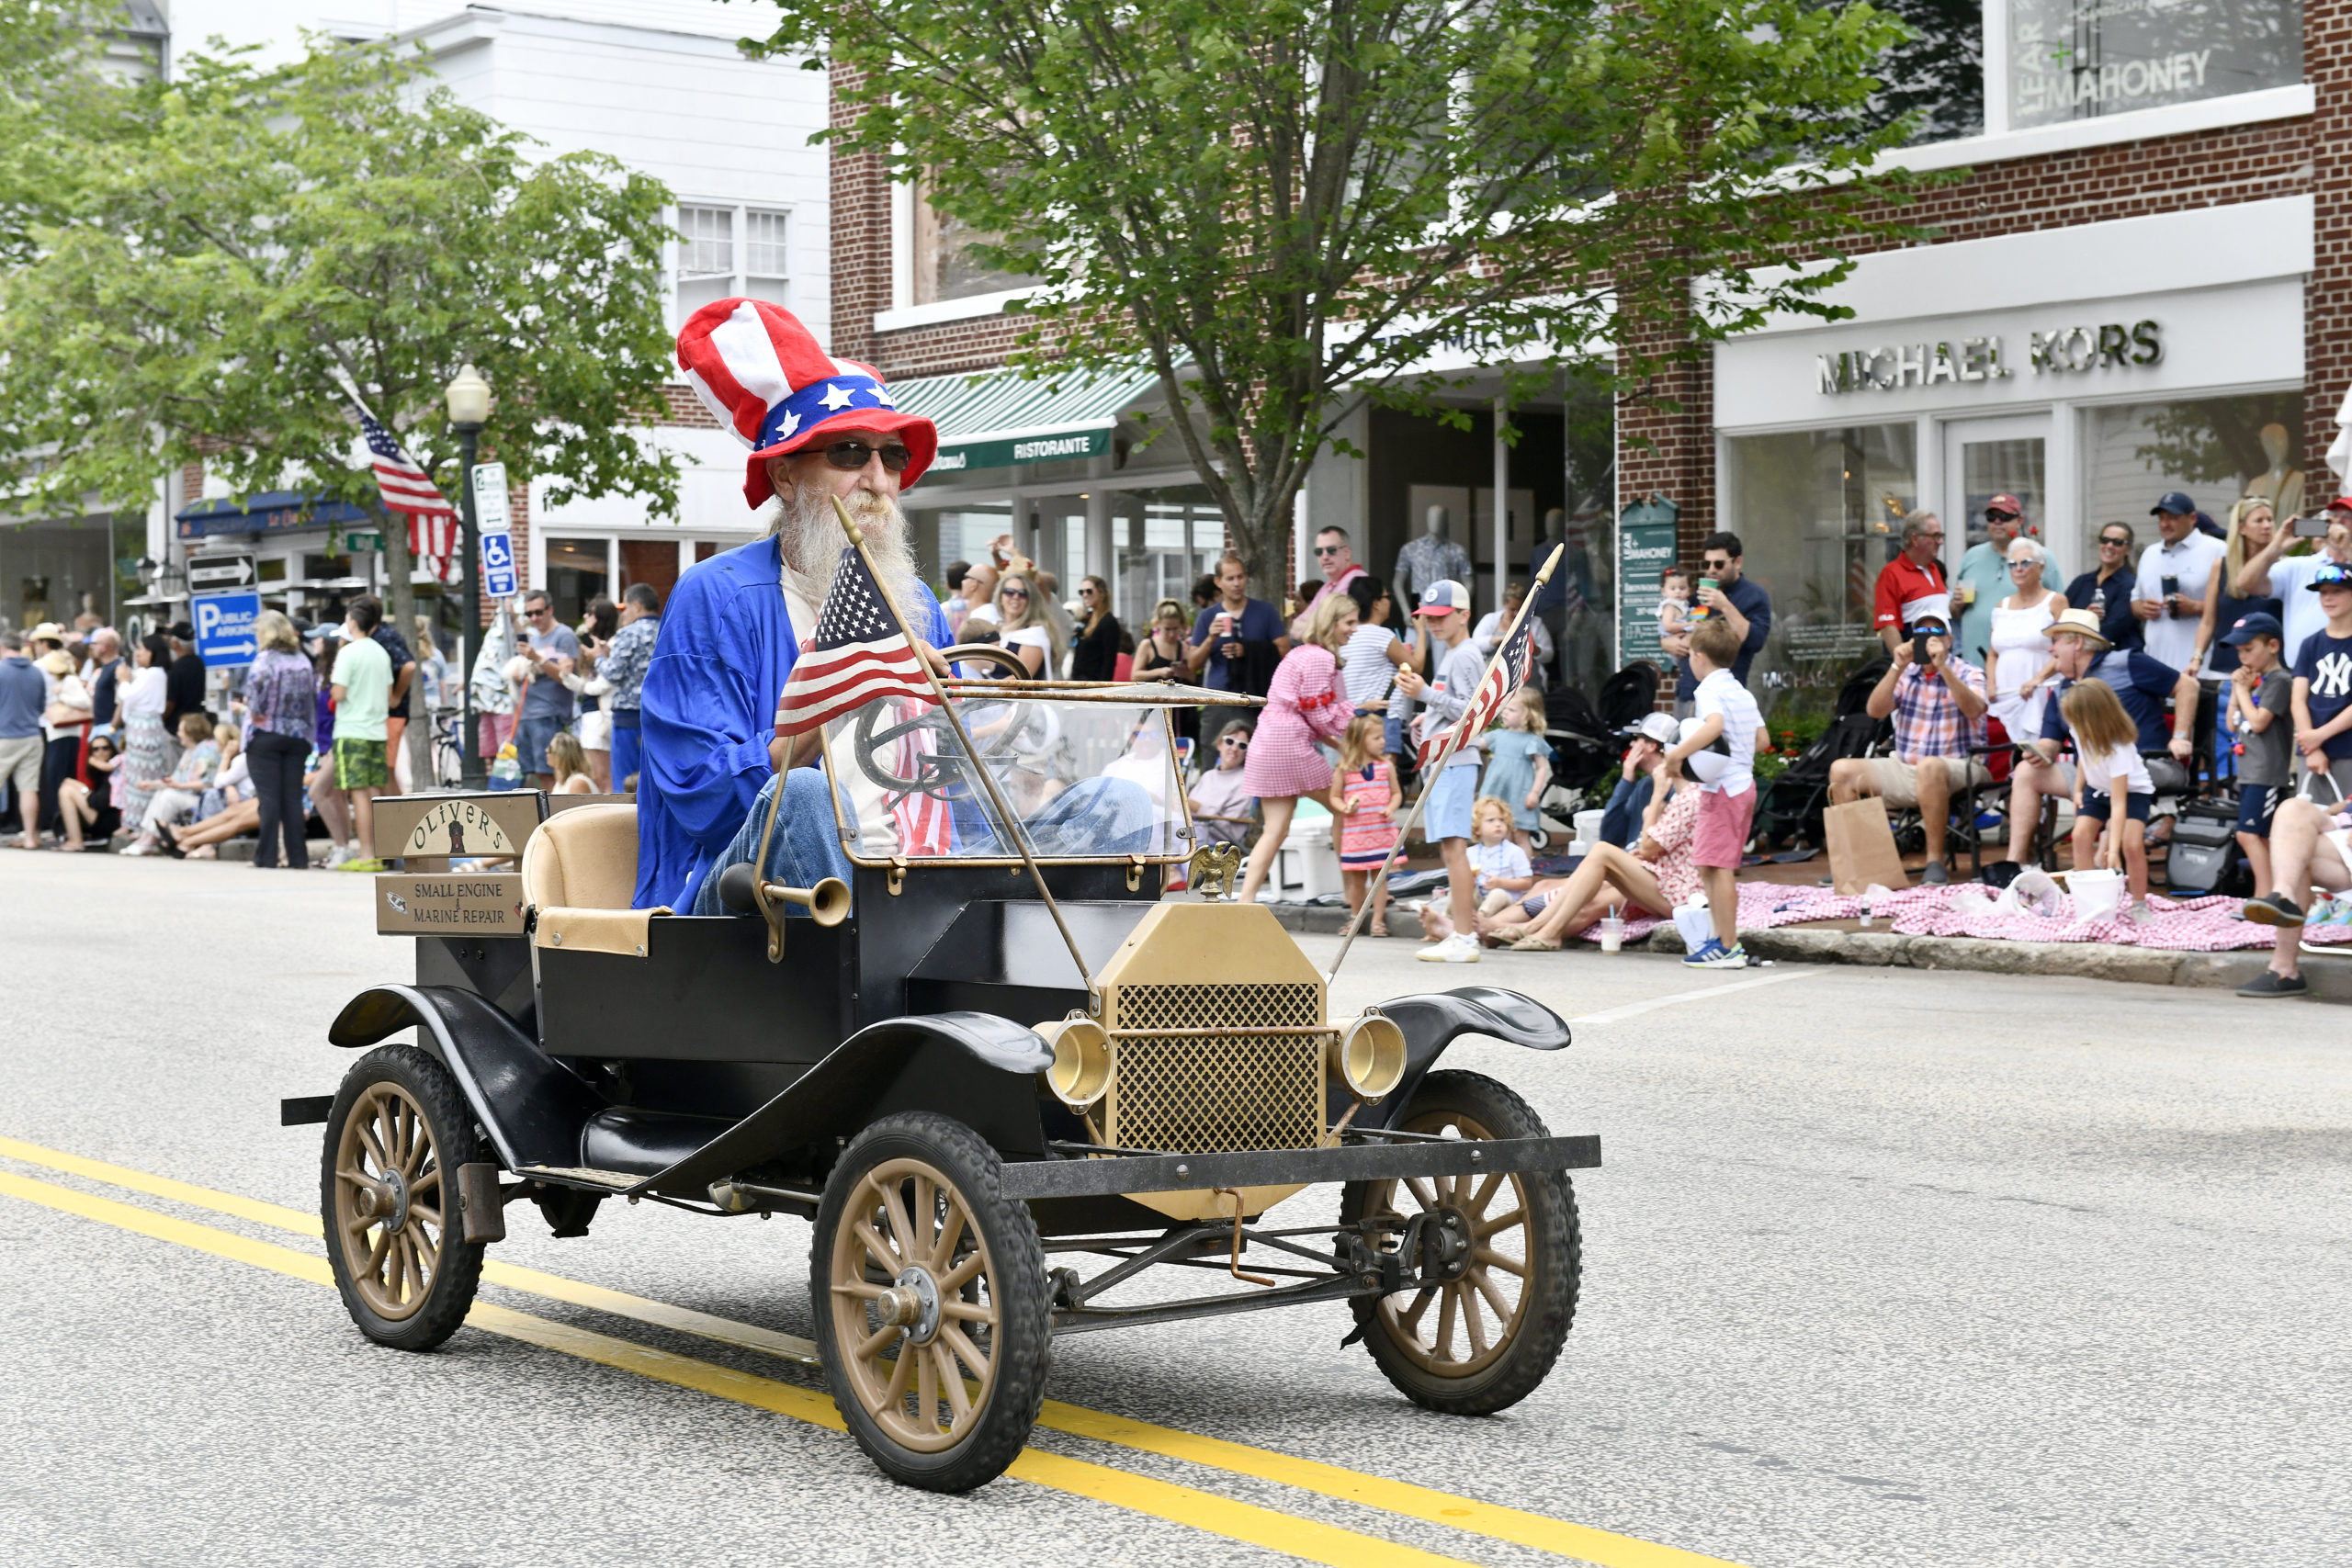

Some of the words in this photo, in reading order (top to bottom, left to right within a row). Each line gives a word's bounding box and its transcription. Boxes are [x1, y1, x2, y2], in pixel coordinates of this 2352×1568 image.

[2017, 21, 2044, 115] LEAR
[2046, 49, 2211, 110] MAHONEY
[1815, 334, 2015, 394] MICHAEL
[2030, 320, 2165, 376] KORS
[1013, 436, 1091, 459] RISTORANTE
[1631, 547, 1673, 560] MAHONEY
[1762, 671, 1837, 688] MICHAEL
[2310, 651, 2352, 695] NY
[414, 884, 456, 897] SMALL
[458, 883, 503, 897] ENGINE
[413, 908, 459, 923] MARINE
[463, 909, 505, 924] REPAIR
